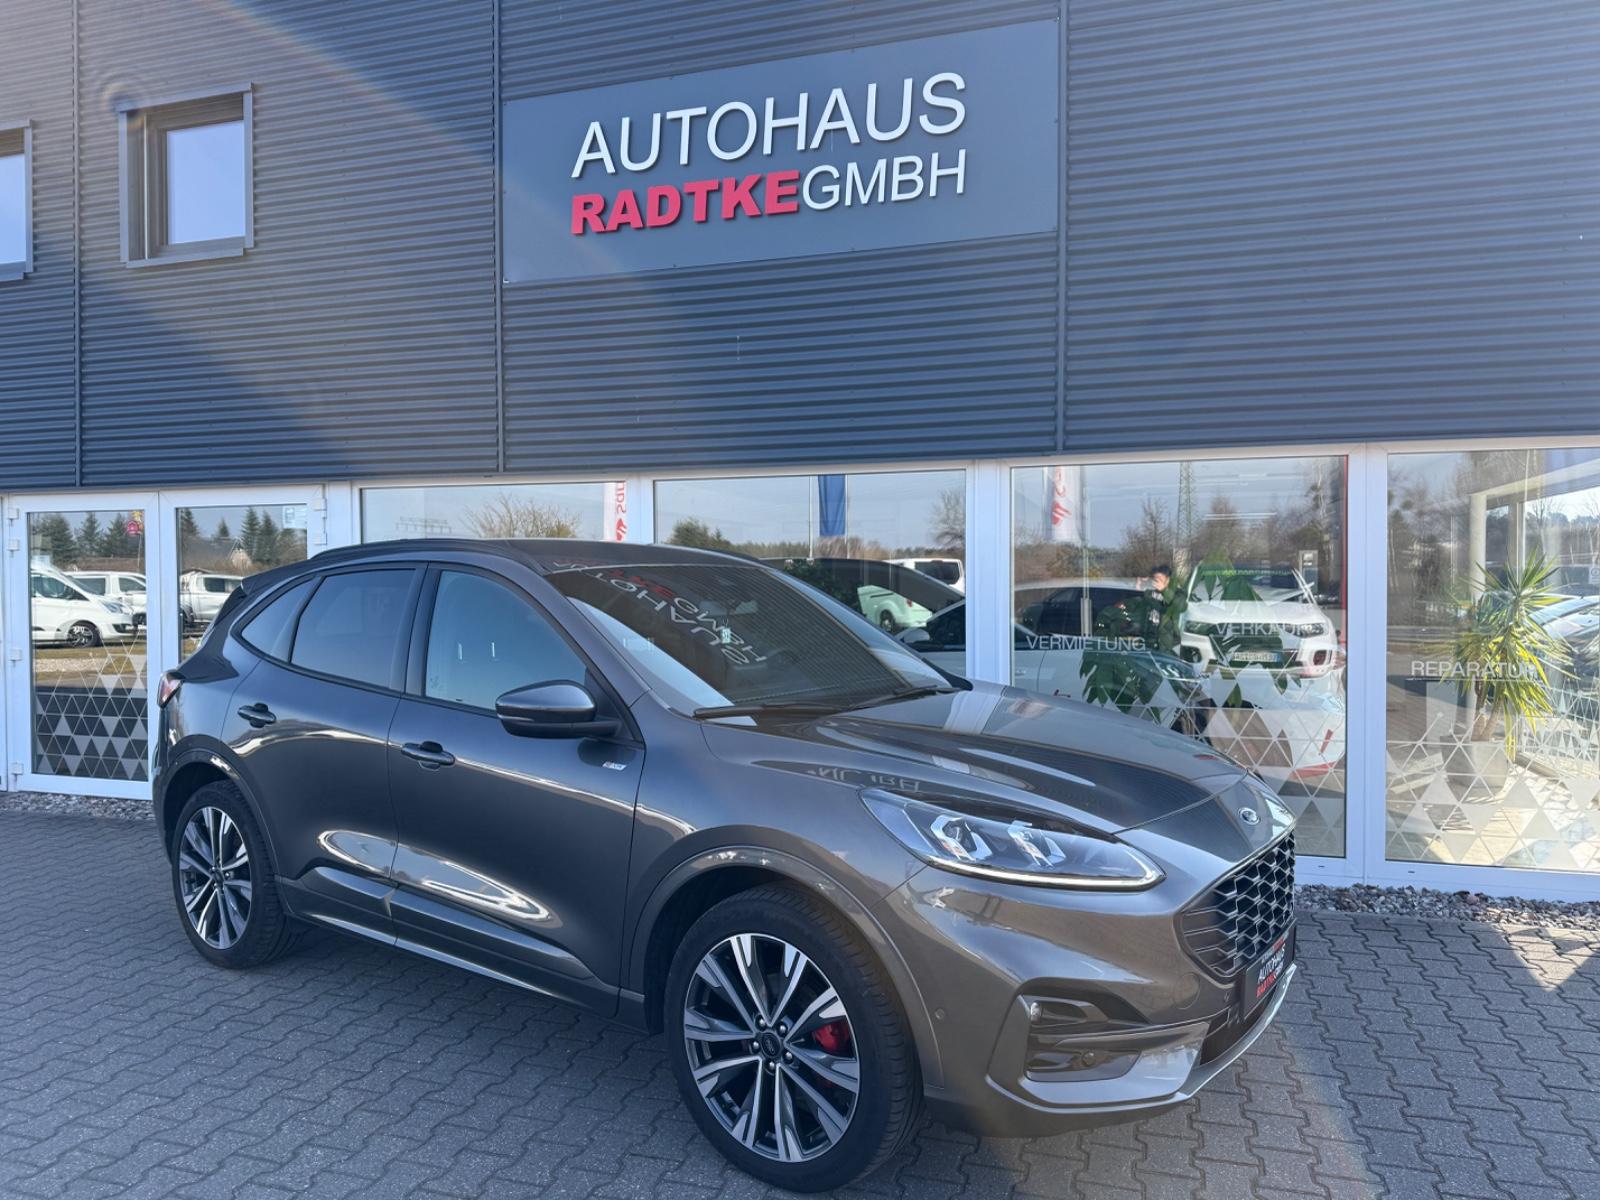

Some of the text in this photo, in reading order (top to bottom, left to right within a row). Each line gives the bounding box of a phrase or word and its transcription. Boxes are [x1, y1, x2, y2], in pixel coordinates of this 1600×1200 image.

[571, 72, 966, 178] AUTOHAUS
[570, 149, 967, 235] RADTKE GMBH
[1026, 635, 1146, 651] VERMIETUNG
